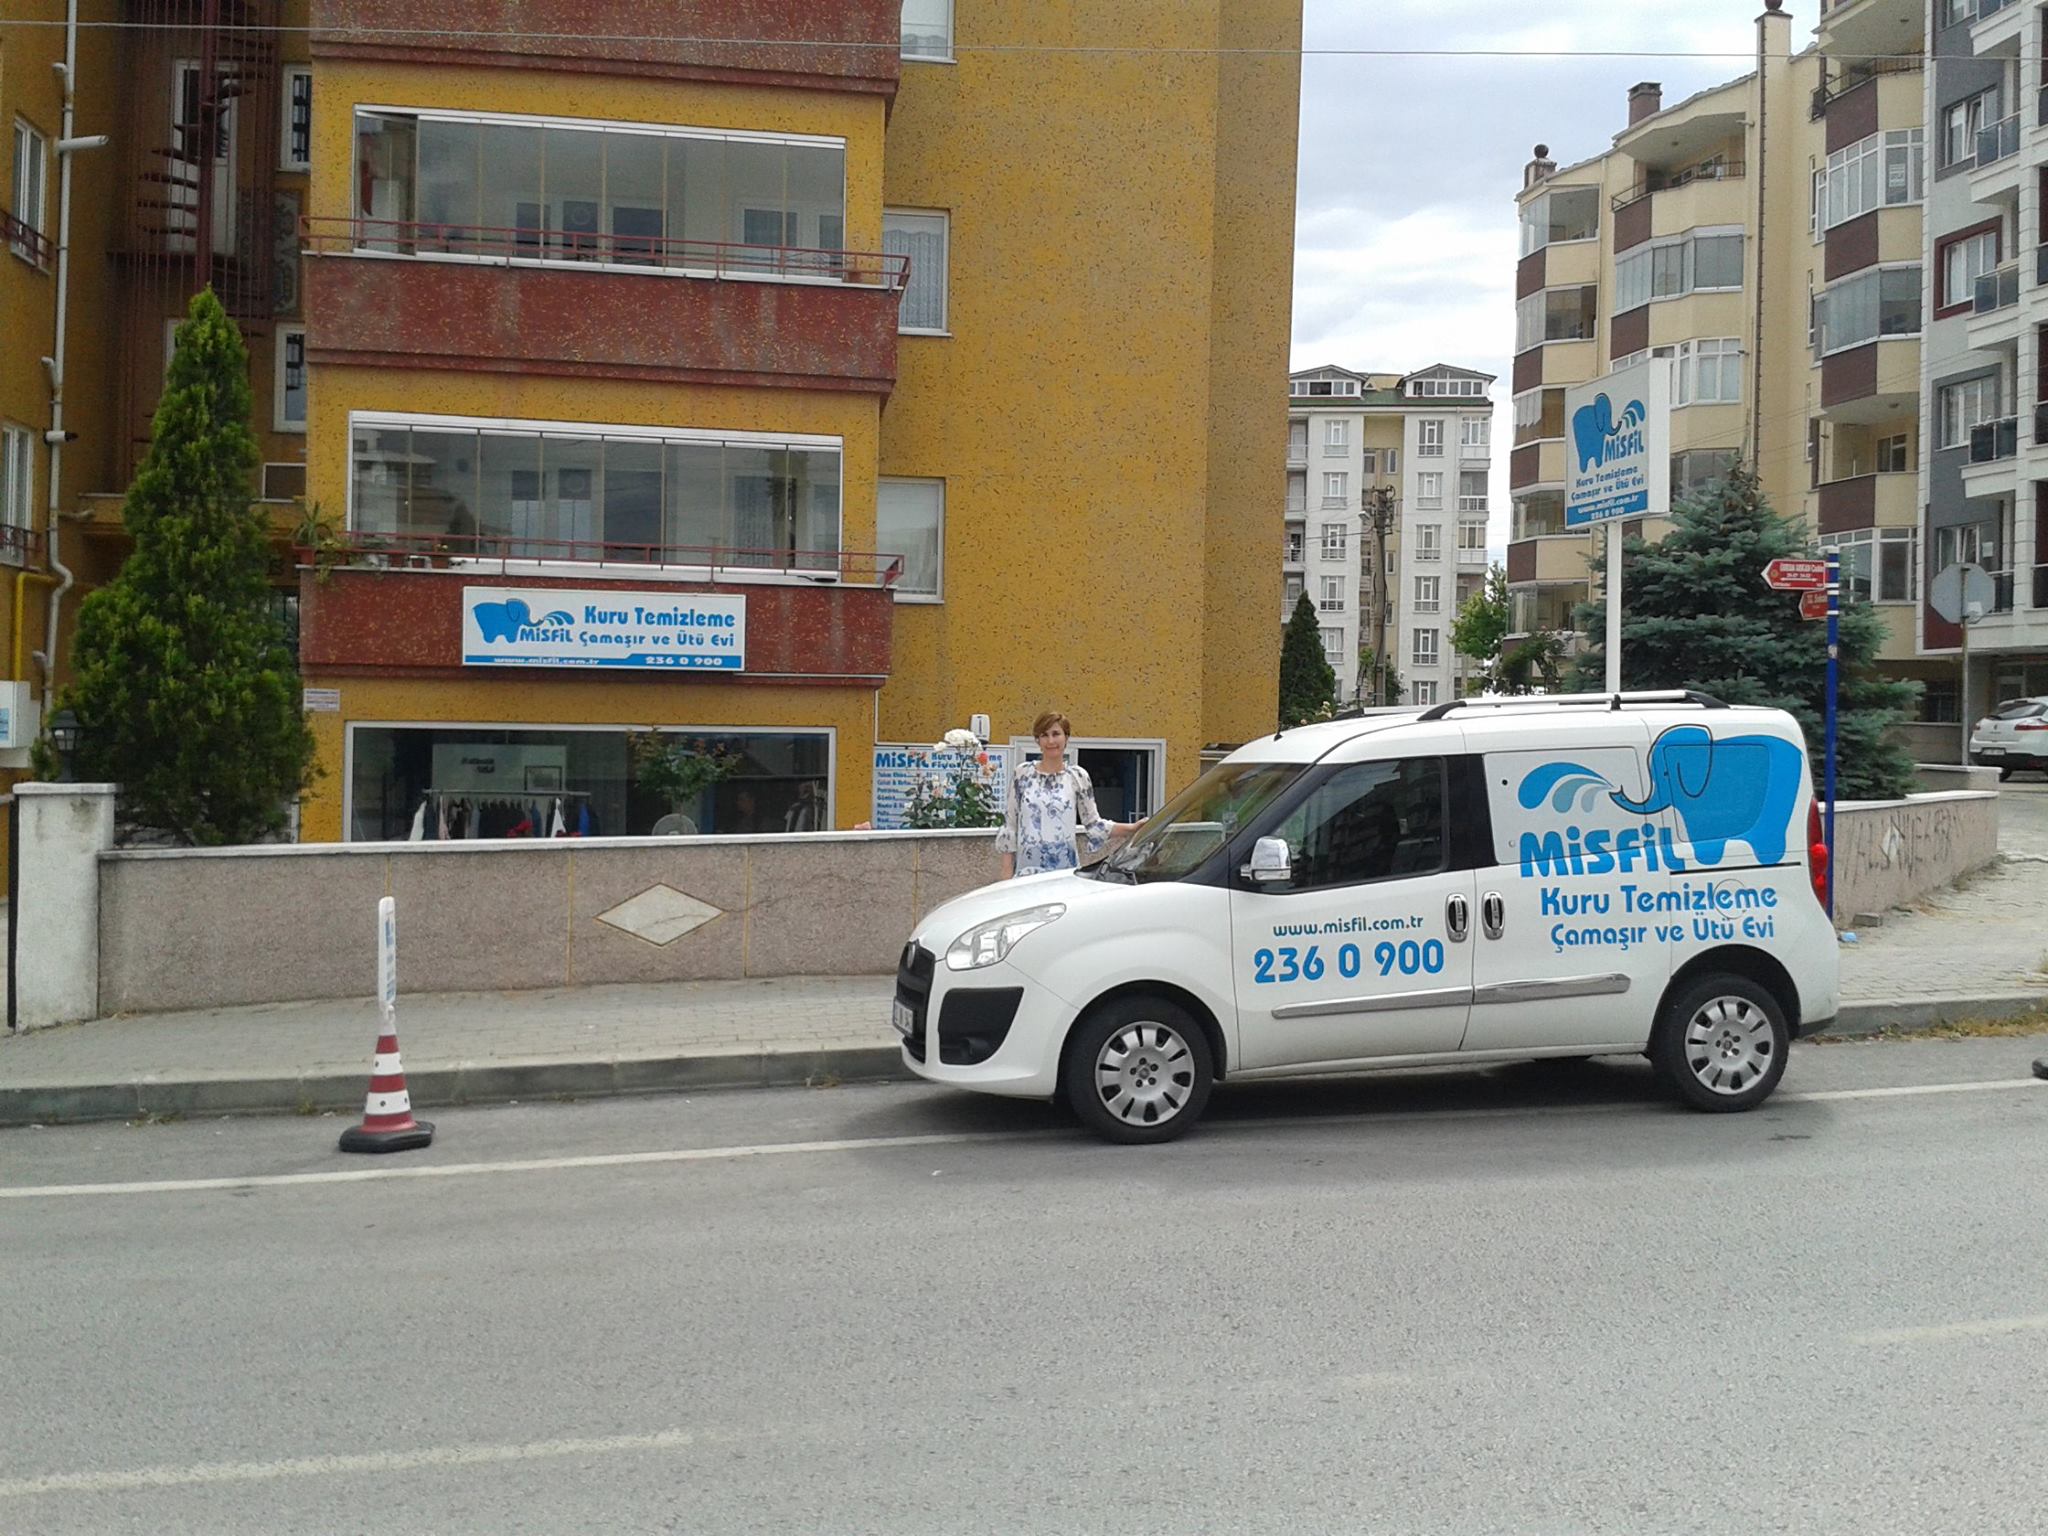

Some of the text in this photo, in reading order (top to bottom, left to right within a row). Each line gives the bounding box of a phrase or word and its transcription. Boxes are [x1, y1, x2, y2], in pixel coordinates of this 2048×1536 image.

[1571, 474, 1644, 503] Çamaşır ve Ütü Evi
[1576, 466, 1638, 488] Kuru Temizleme
[584, 605, 736, 628] Kuru Temizleme
[579, 629, 735, 648] Çamaşır ve Ütü Evi
[493, 656, 600, 666] www.misfil.com.tr
[645, 656, 723, 666] 236 0 900
[1519, 823, 1686, 878] MiSFiL
[1541, 882, 1778, 916] Kuru Temizleme
[1273, 915, 1424, 937] www.misfil.com.tr
[1551, 912, 1775, 953] Çamaşır ve Ütü Evi
[1254, 938, 1445, 984] 236 0 900
